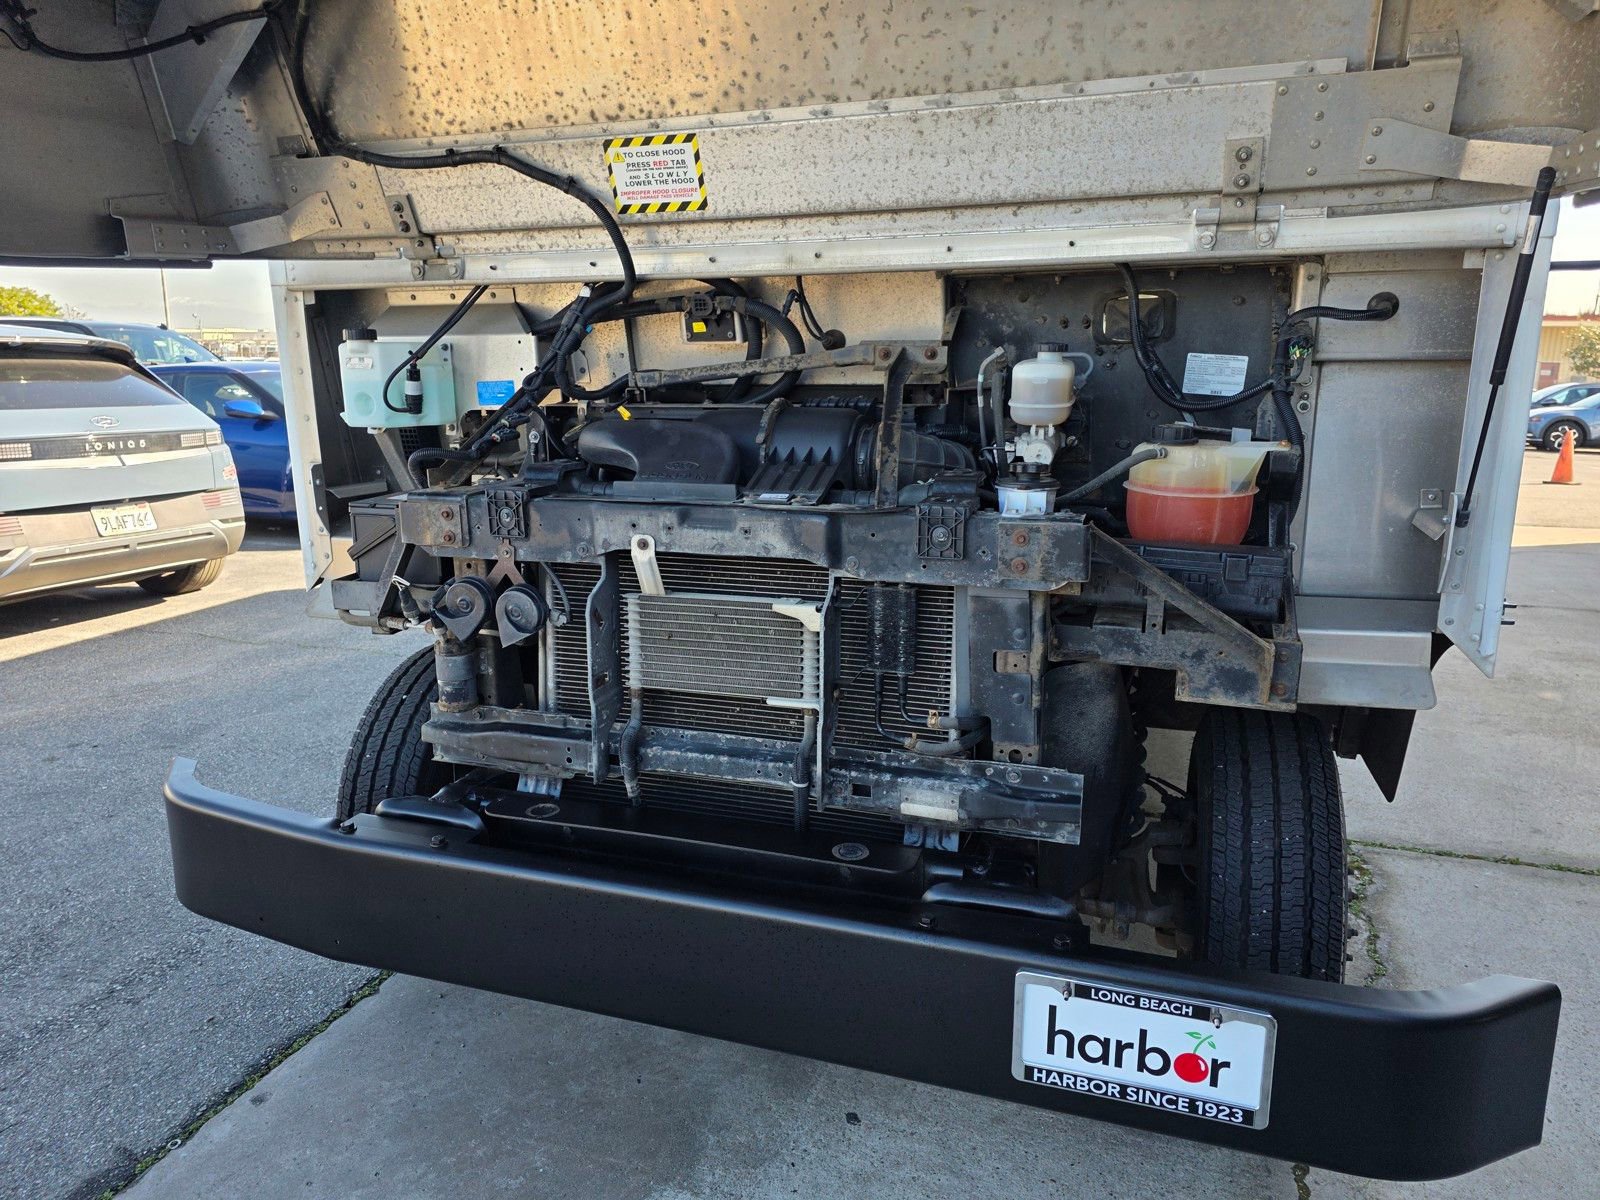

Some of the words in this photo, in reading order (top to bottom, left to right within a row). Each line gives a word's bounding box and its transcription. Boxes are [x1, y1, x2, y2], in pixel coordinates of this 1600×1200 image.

[86, 440, 136, 451] IONIQ
[1090, 988, 1136, 1006] LONG
[1139, 996, 1193, 1017] BEACH
[1046, 1005, 1231, 1088] harbor
[1033, 1069, 1121, 1098] HARBOR
[1126, 1087, 1190, 1112] SINCE
[1195, 1100, 1243, 1123] 1923
